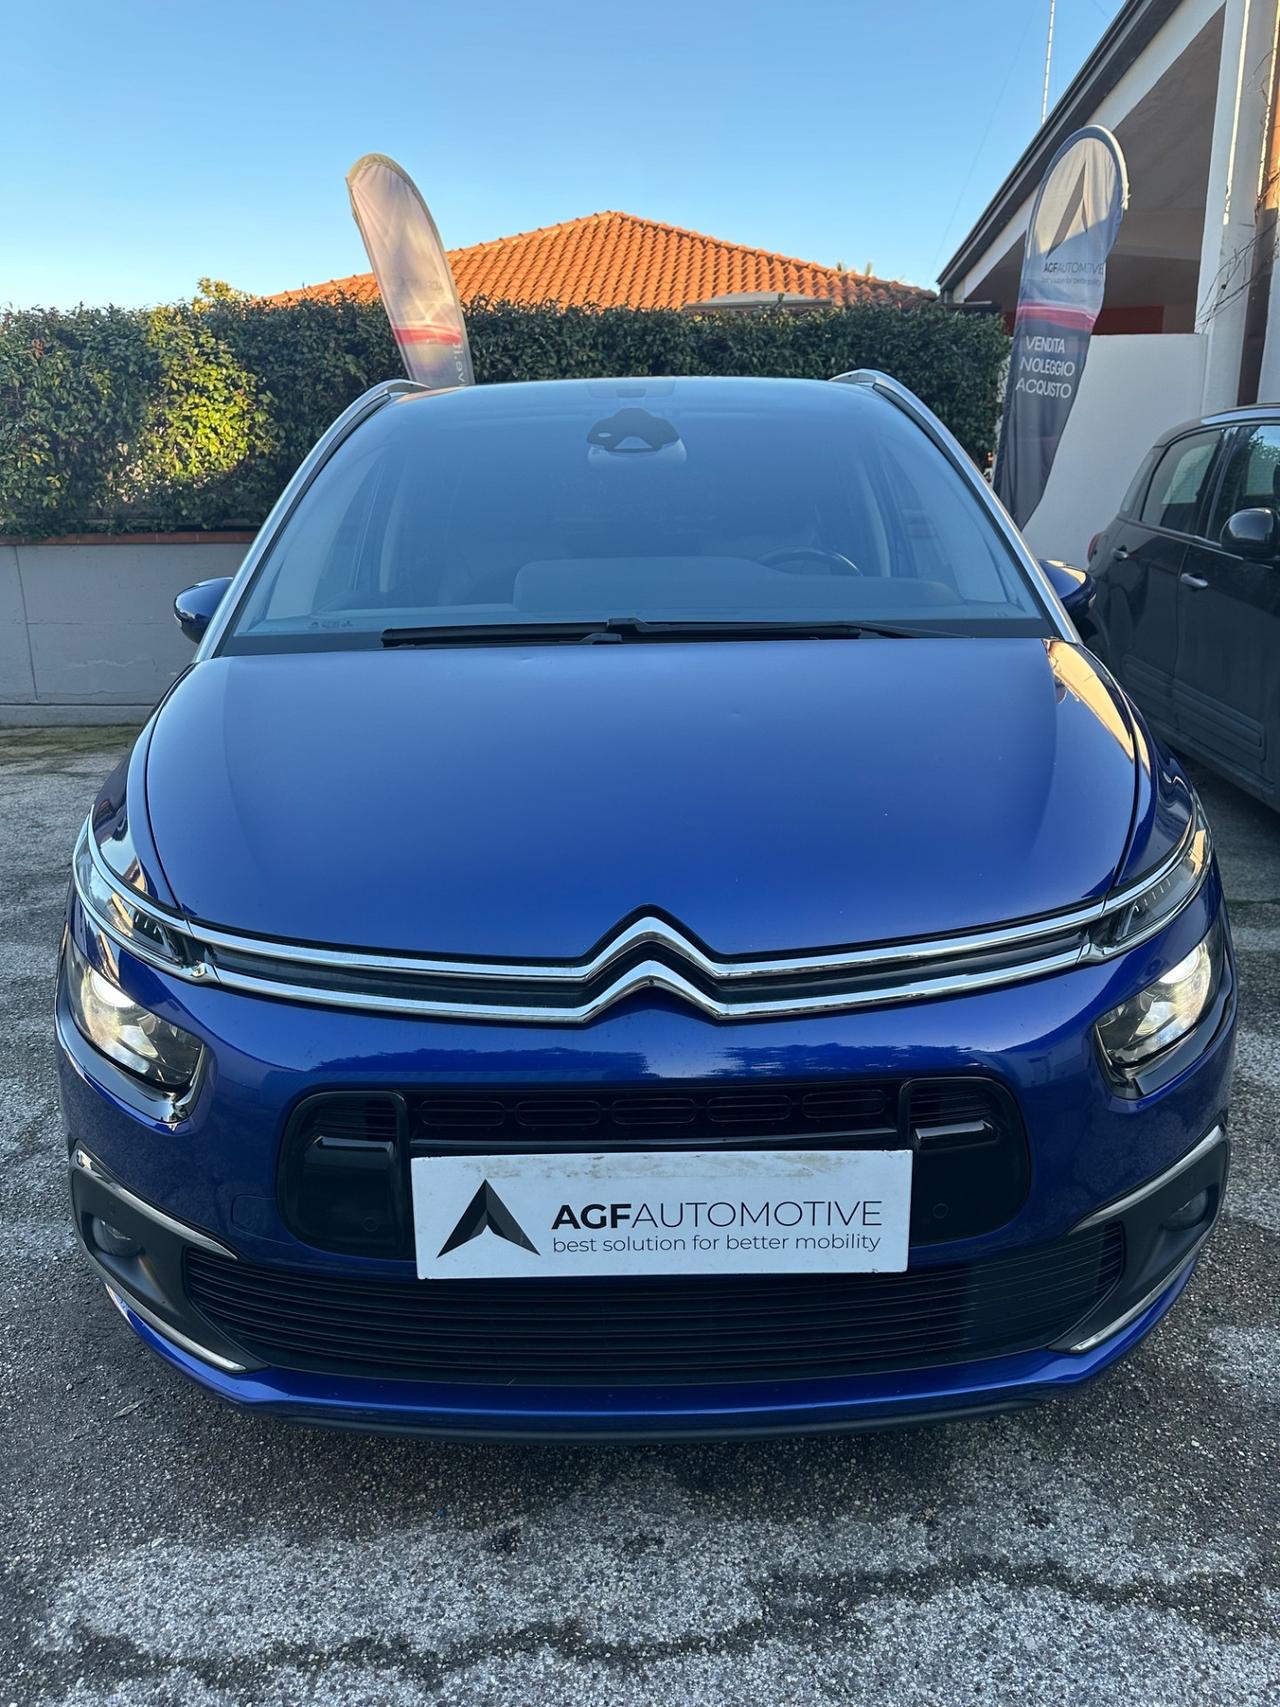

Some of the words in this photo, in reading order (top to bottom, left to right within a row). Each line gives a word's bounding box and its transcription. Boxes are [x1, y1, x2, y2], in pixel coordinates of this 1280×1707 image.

[1043, 262, 1104, 275] AGFAUTOMTIVE
[1026, 335, 1065, 353] VENDITA
[1020, 356, 1075, 376] NOLEGGIO
[1015, 377, 1071, 398] ACQUSTO
[551, 1200, 882, 1230] AGFAUTOMOTIVE
[553, 1237, 597, 1252] best
[602, 1235, 686, 1251] solution
[693, 1234, 720, 1251] for
[726, 1234, 789, 1250] better
[795, 1233, 881, 1252] mobility
